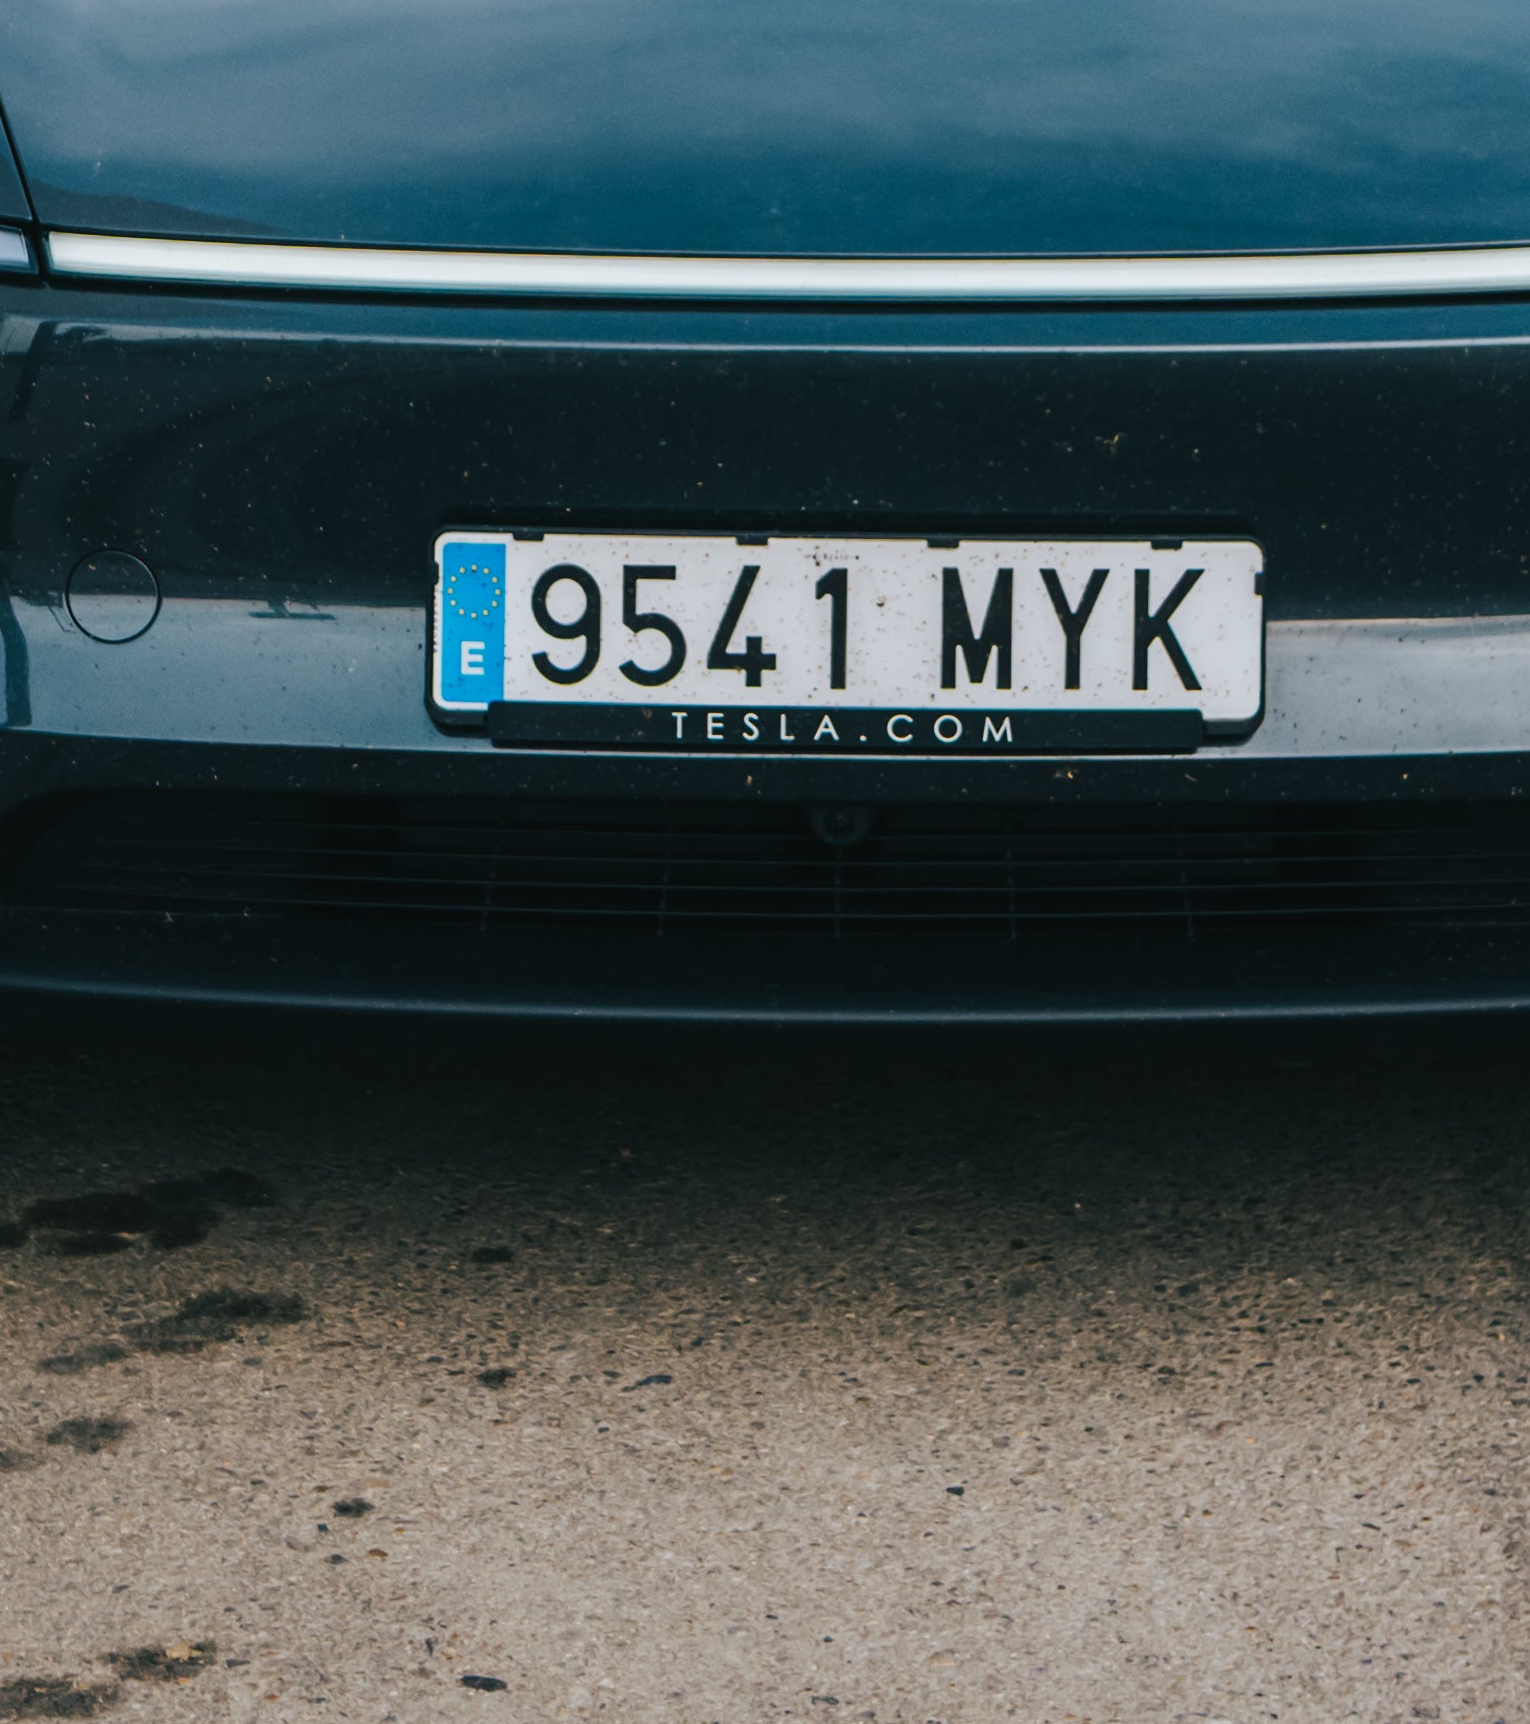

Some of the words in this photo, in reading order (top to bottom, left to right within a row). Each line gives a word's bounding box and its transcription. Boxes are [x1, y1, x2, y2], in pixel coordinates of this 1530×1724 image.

[531, 564, 849, 691] 9541
[940, 567, 1205, 691] MYK
[461, 641, 486, 676] E
[671, 711, 1014, 744] TESLA.COM
